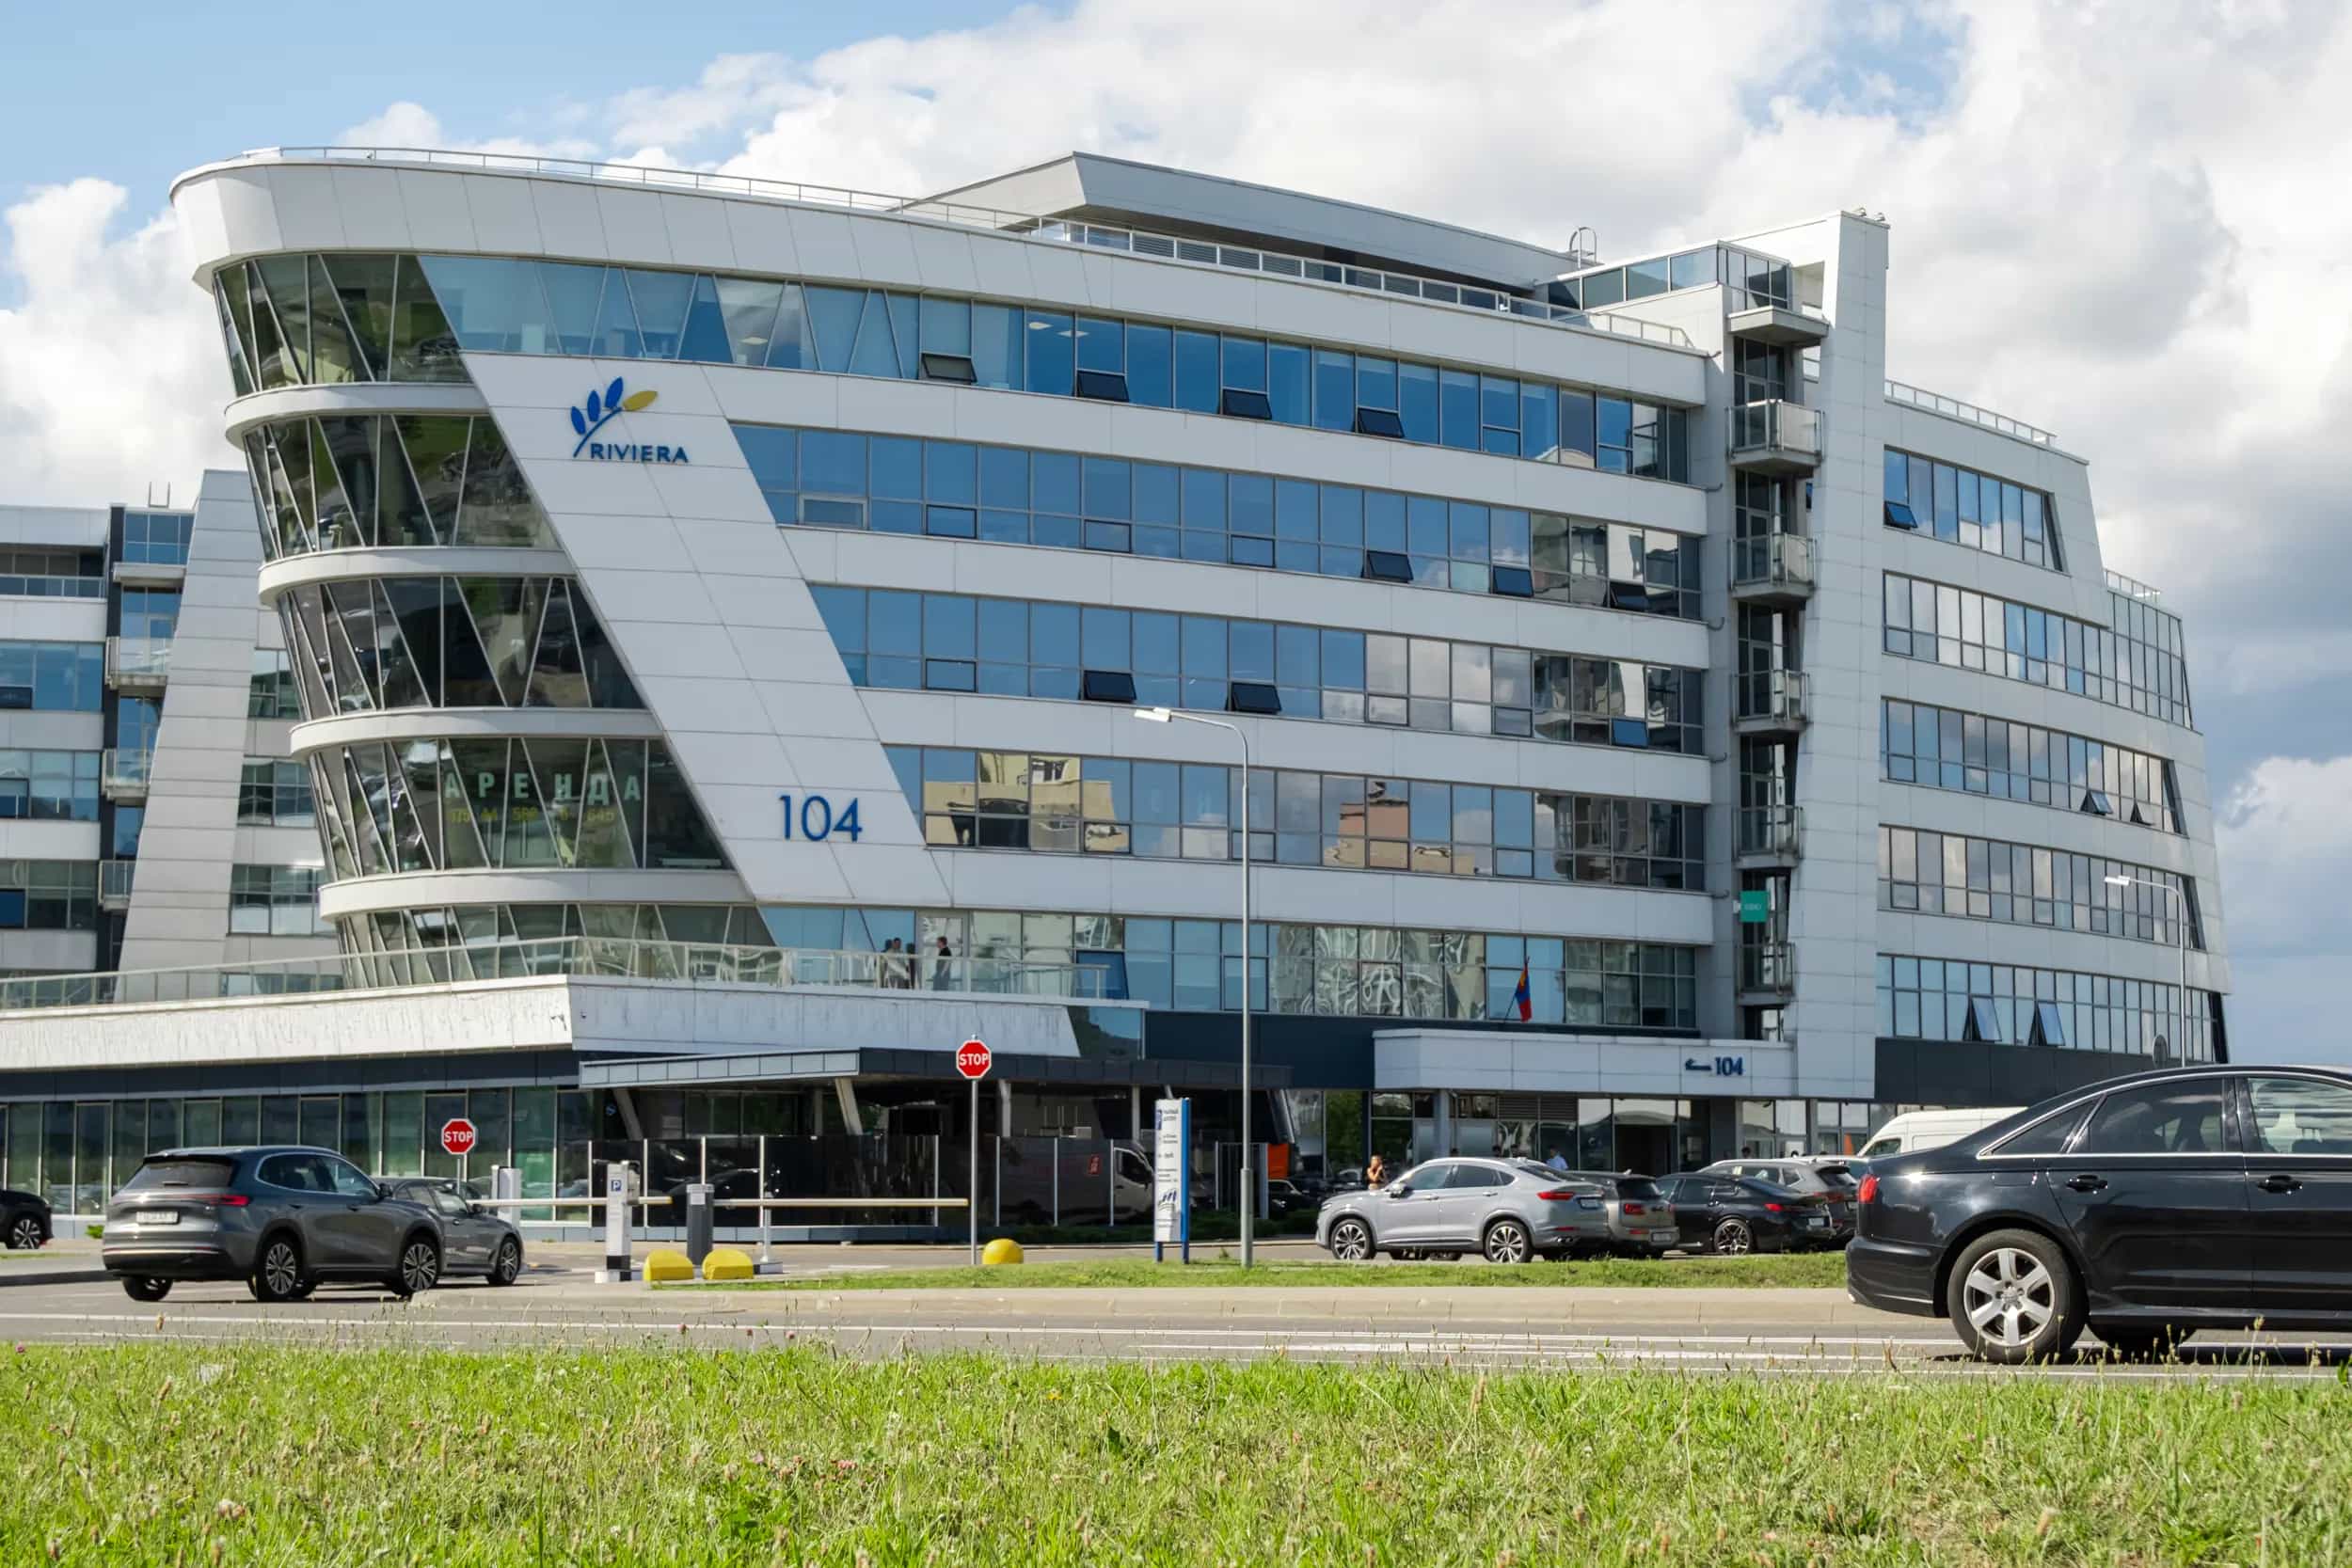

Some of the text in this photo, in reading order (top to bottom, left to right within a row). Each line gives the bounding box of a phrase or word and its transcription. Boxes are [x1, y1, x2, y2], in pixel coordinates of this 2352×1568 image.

[590, 442, 689, 464] RIVIERA
[445, 771, 642, 806] АРЕНДА
[779, 795, 863, 843] 104
[959, 1053, 989, 1067] STOP
[1715, 1056, 1744, 1076] 104
[443, 1131, 473, 1144] STOP
